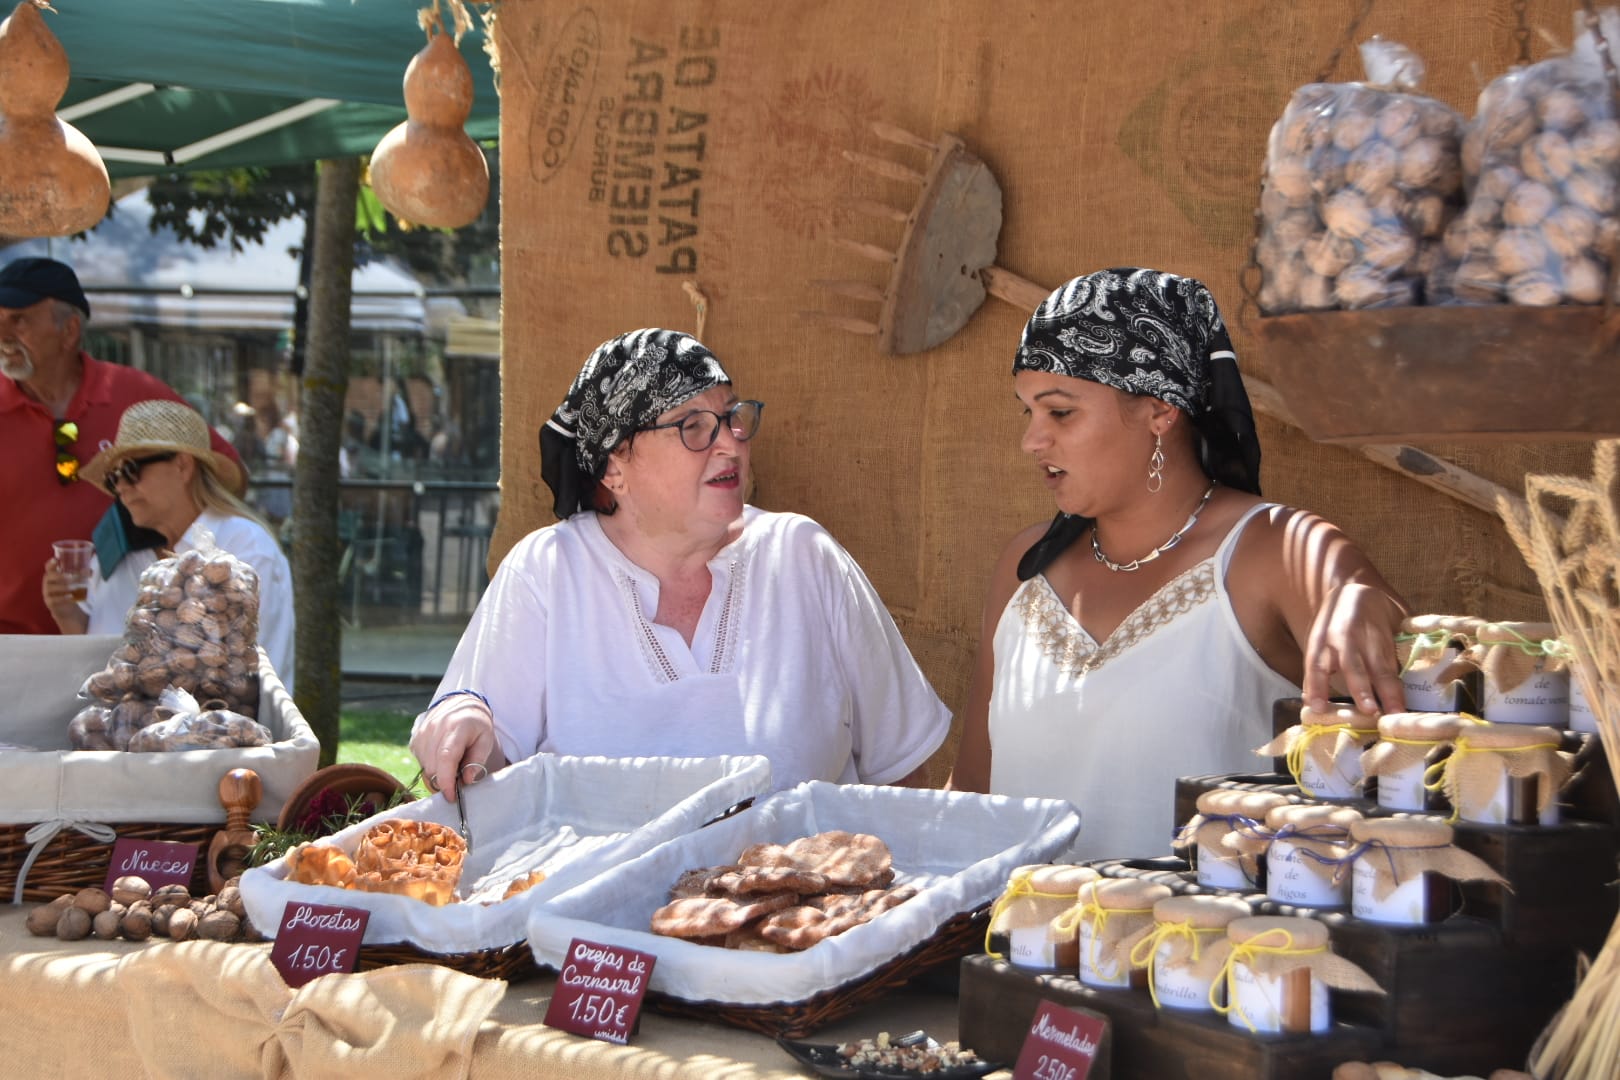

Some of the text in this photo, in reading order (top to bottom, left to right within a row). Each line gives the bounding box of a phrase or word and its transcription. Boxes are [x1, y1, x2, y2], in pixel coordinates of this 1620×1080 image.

[1533, 676, 1551, 689] de
[121, 849, 190, 875] Nueces
[1284, 867, 1299, 880] de
[1277, 884, 1307, 900] higos
[287, 943, 348, 970] 1.50€
[574, 943, 646, 974] Orejas de
[562, 964, 642, 995] Carnaval
[568, 992, 630, 1027] 1.50€
[593, 1028, 628, 1043] unidad
